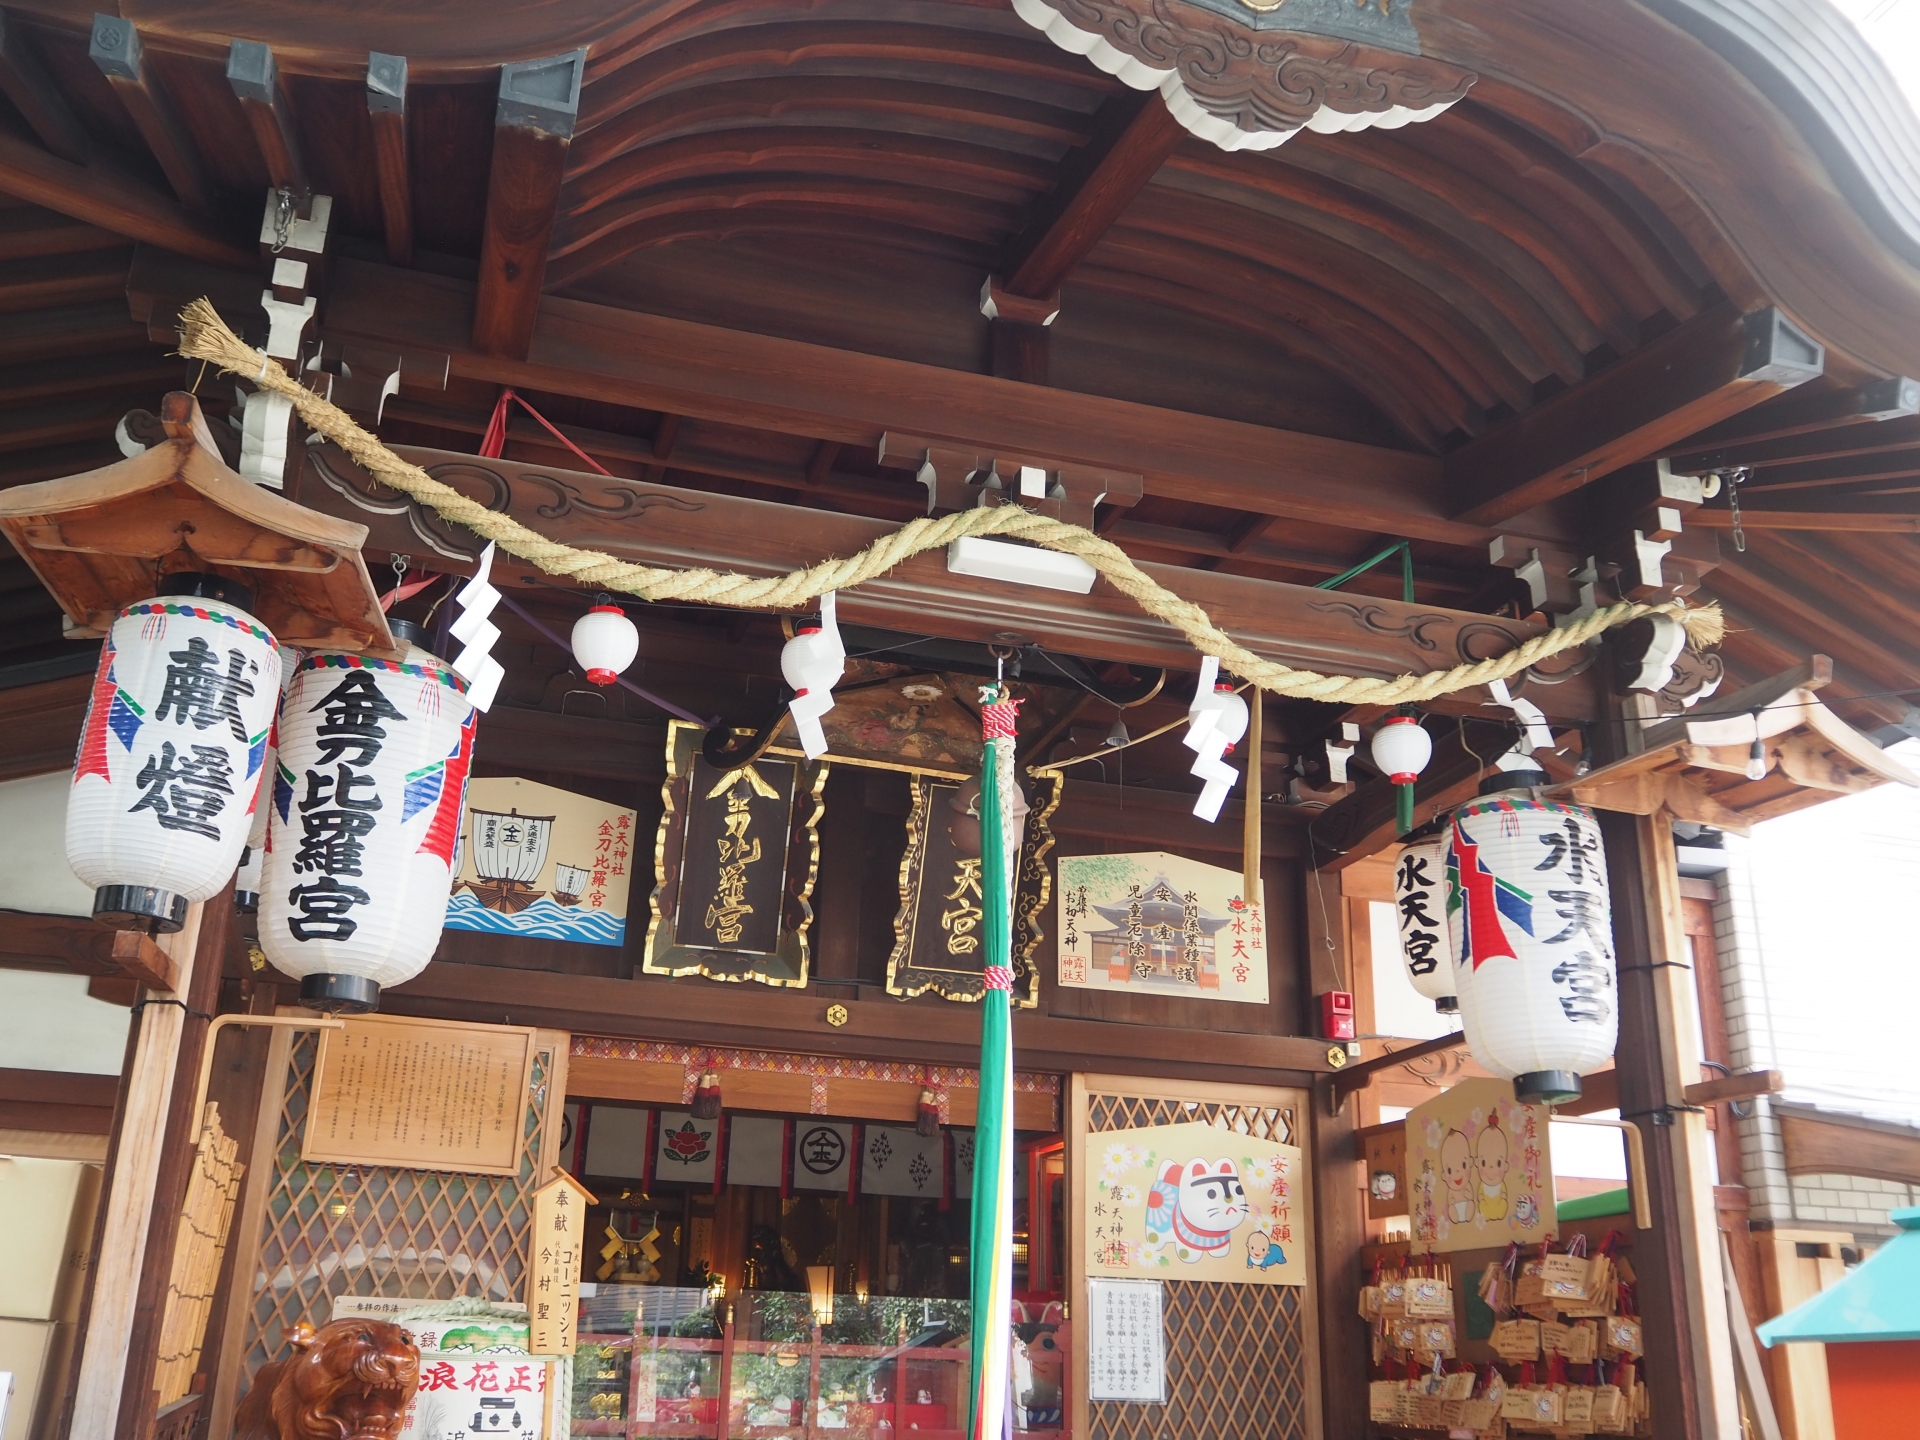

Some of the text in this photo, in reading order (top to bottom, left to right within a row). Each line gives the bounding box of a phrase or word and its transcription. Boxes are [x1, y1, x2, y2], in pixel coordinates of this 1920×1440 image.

[287, 669, 408, 942] 金刀比羅宮
[502, 824, 521, 844] 金
[525, 824, 538, 853] 交通安全
[589, 819, 615, 908] 金刀比羅宮
[610, 814, 631, 876] 露天神社
[1064, 890, 1079, 953] お初天神
[1155, 887, 1171, 940] 安産
[1183, 890, 1200, 962] 水関係業種
[1396, 854, 1440, 977] 水天宮
[1533, 816, 1613, 1026] 水天宮
[1231, 916, 1250, 983] 水天宮
[554, 1188, 569, 1232] 奉献
[1270, 1153, 1293, 1244] 安産祈願
[553, 1240, 561, 1284] 代表取締役
[572, 1242, 580, 1285] 株式会社
[1094, 1201, 1107, 1264] 水天宮
[356, 1302, 399, 1313] 参拝の作法
[536, 1247, 552, 1348] 今村聖三
